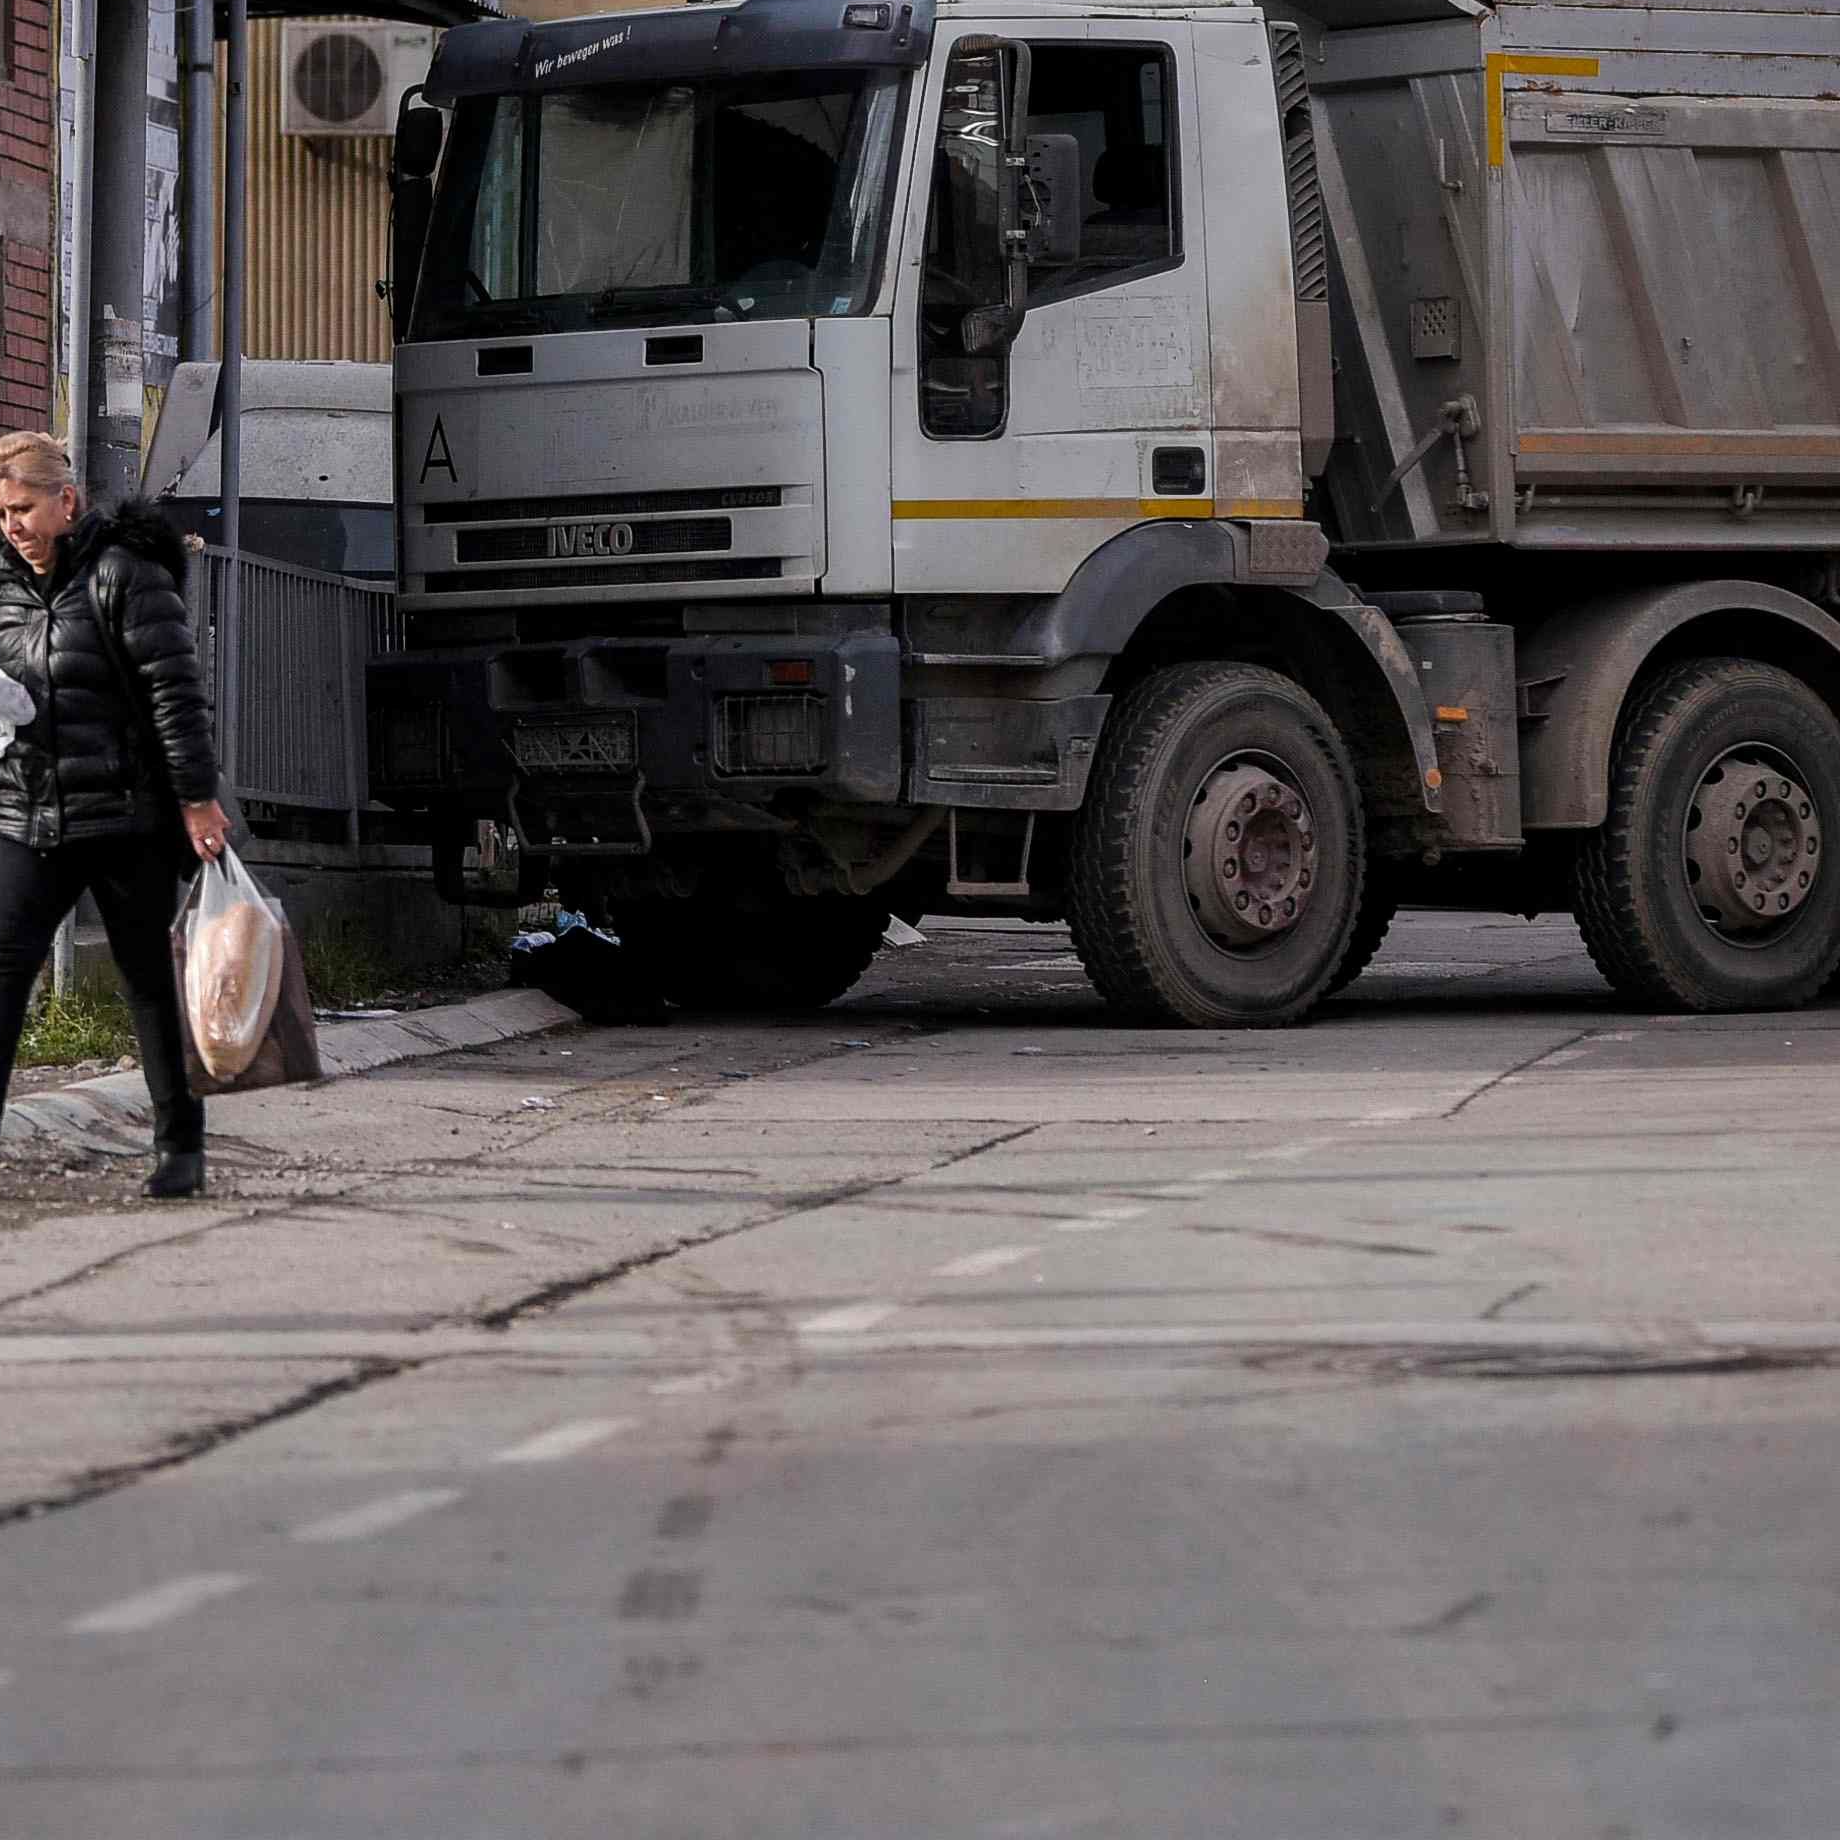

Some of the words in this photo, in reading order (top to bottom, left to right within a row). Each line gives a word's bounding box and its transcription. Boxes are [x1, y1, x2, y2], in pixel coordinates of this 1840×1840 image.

[535, 59, 555, 79] Wir
[556, 41, 600, 69] bewegen
[602, 31, 624, 50] was
[419, 412, 459, 485] A
[550, 522, 634, 557] IVECO
